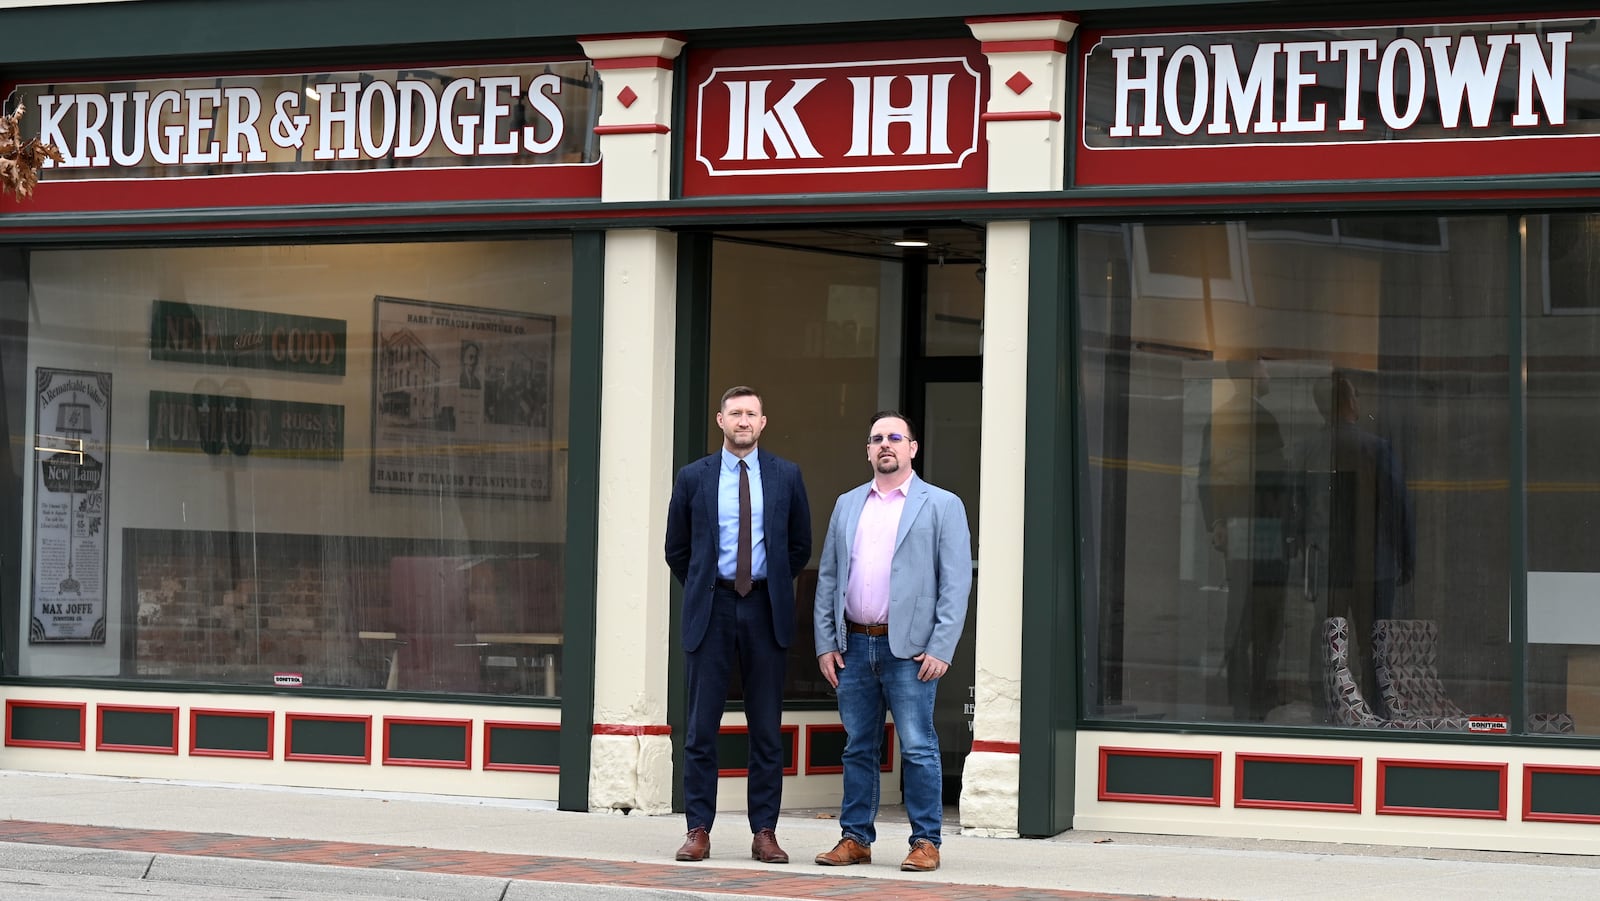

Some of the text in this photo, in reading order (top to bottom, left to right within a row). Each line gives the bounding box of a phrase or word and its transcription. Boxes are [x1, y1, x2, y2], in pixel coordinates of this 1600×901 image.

[1109, 32, 1573, 138] HOMETOWN
[37, 73, 565, 170] KRUGER & HODGES
[407, 313, 434, 325] HARRY
[271, 325, 336, 365] GOOD
[46, 378, 86, 402] Remarkable
[282, 411, 321, 431] RUGS
[48, 466, 100, 484] New Lamp
[376, 469, 415, 483] HARRY
[42, 602, 93, 615] MAX JOFFE
